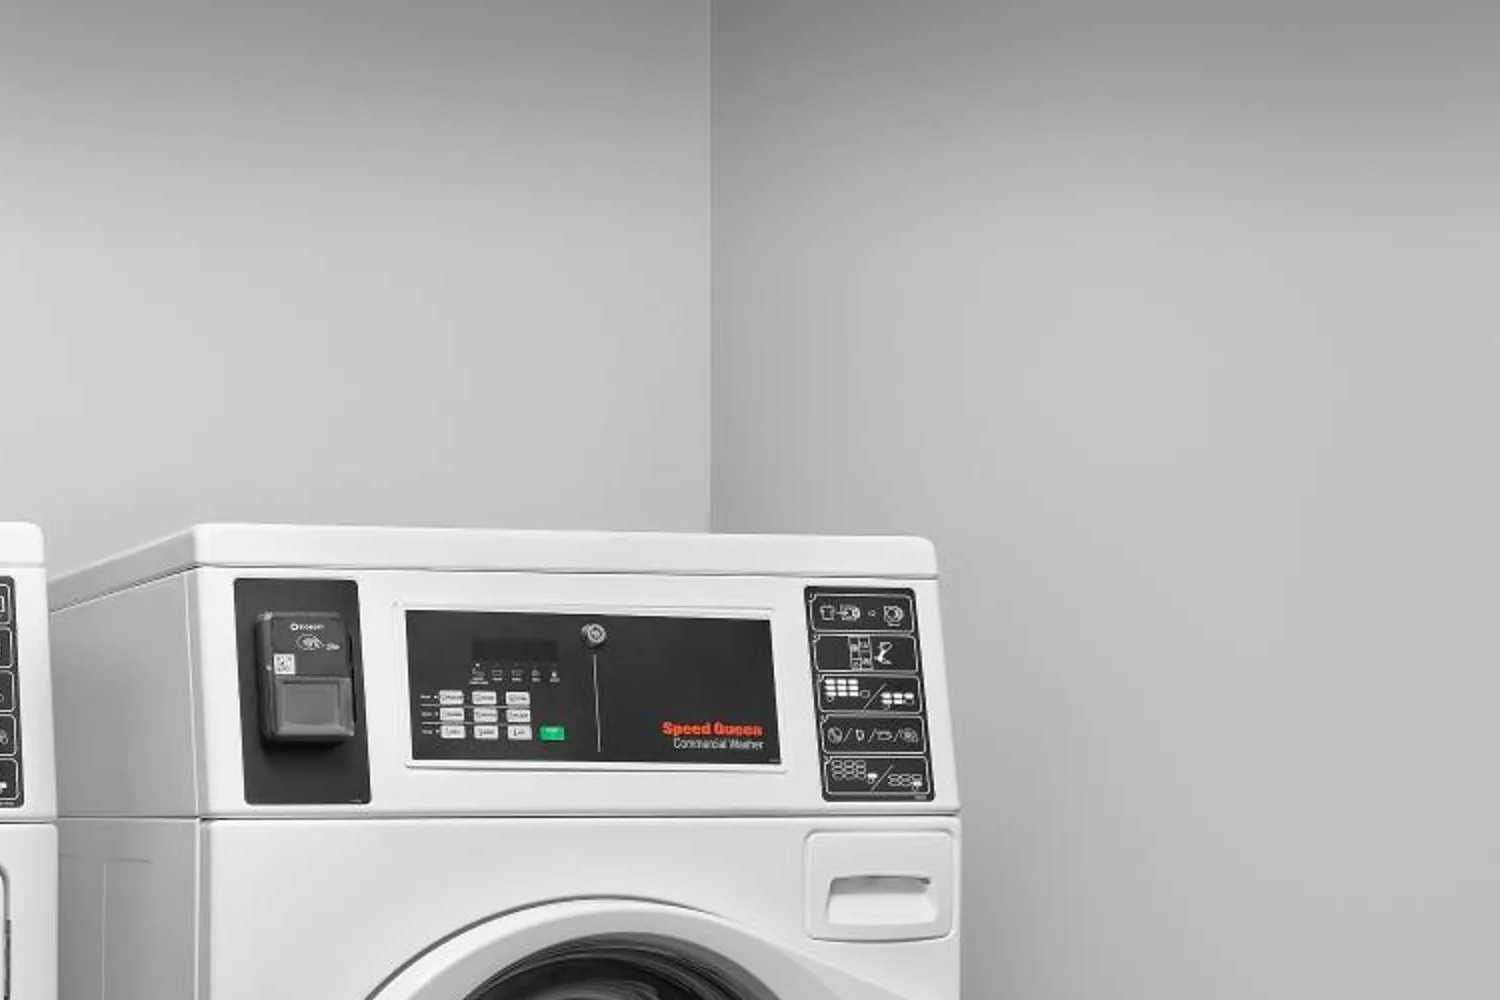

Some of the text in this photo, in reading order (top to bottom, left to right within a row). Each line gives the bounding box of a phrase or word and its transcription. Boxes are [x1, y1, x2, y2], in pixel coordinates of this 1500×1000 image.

[661, 721, 764, 737] Speed Queen
[673, 737, 726, 749] Commercial
